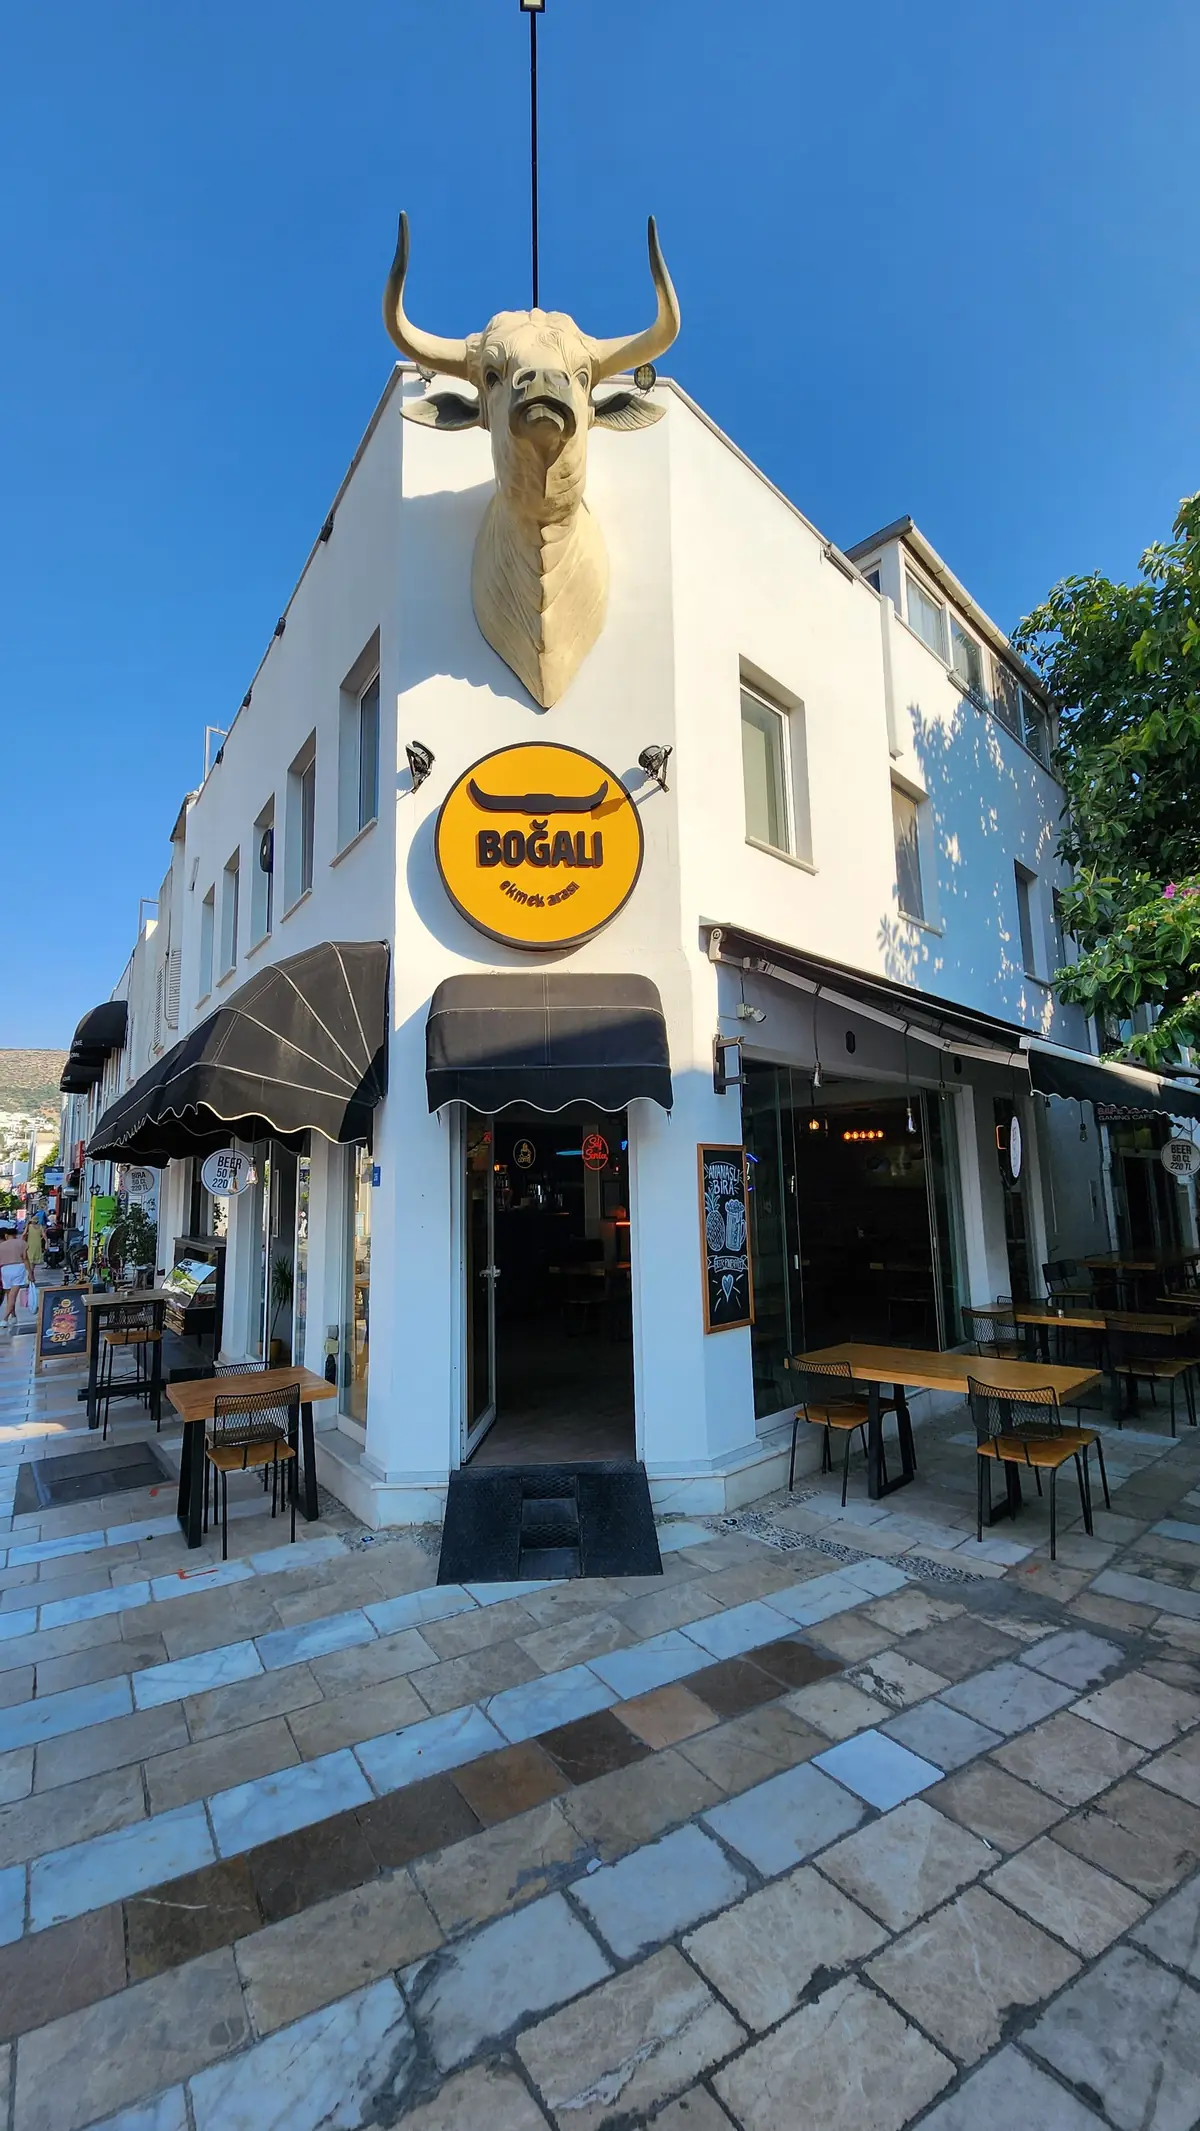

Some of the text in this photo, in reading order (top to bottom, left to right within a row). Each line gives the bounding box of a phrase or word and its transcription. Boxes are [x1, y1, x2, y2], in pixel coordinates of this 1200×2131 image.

[475, 819, 604, 868] BOĞALI
[499, 880, 580, 907] ekmek arası
[1171, 1144, 1192, 1155] BEER
[217, 1156, 242, 1169] BEER
[1172, 1154, 1191, 1163] 50 CL
[1171, 1162, 1192, 1170] 220 TL
[216, 1168, 228, 1178] 50
[212, 1178, 228, 1189] 220
[54, 1332, 71, 1341] 590
